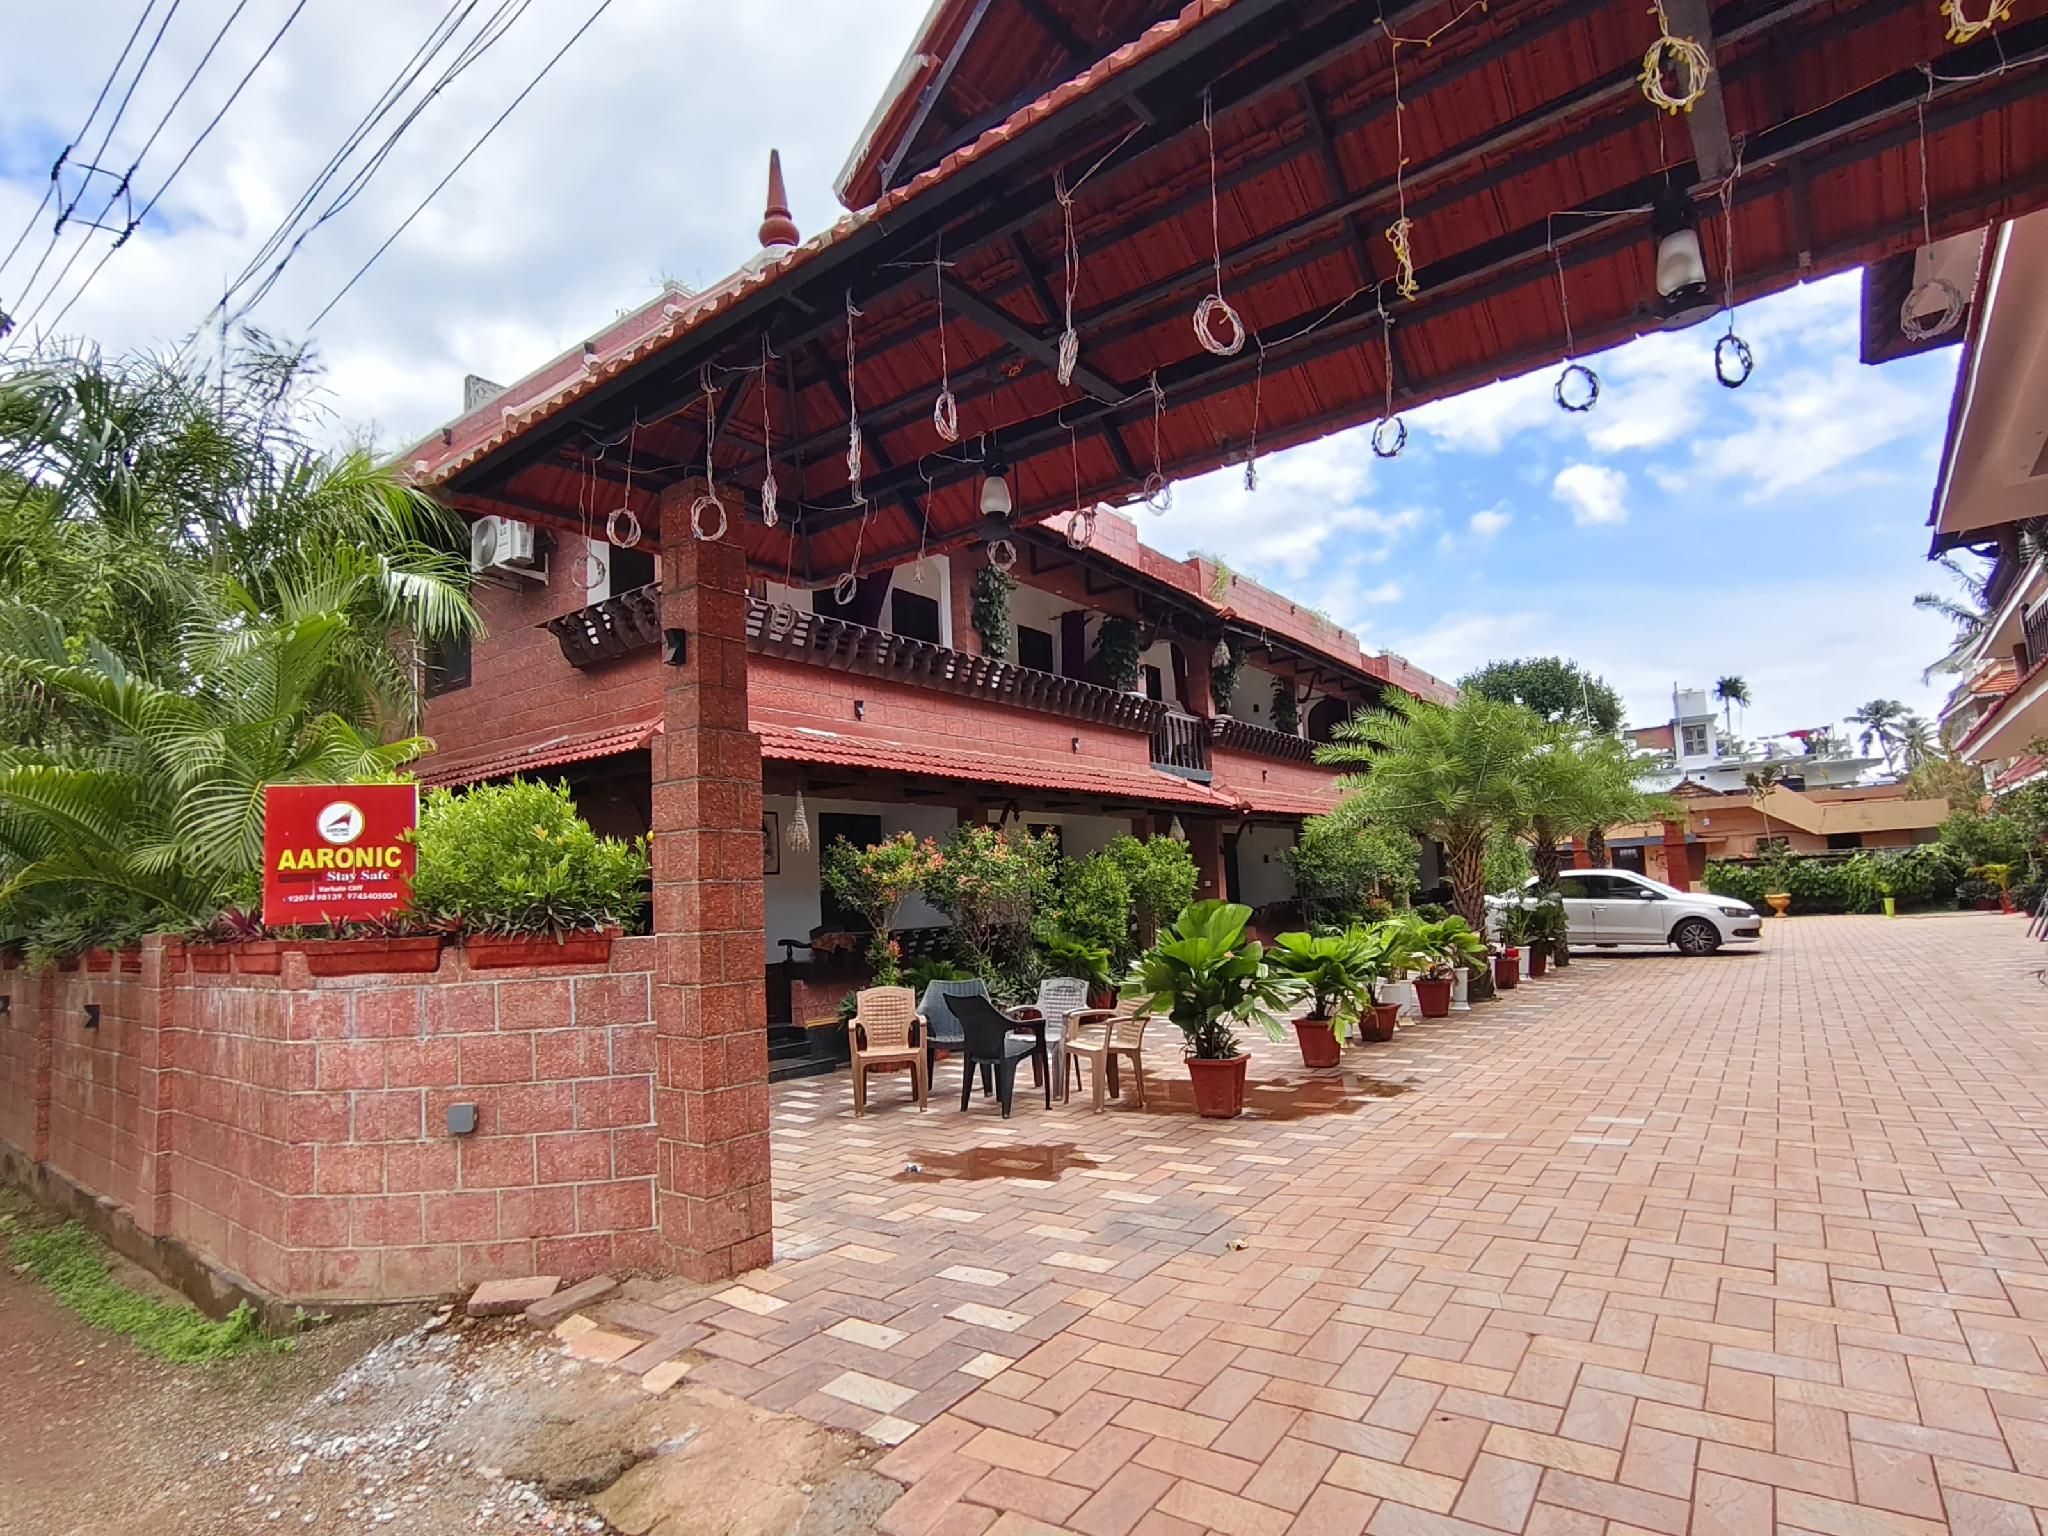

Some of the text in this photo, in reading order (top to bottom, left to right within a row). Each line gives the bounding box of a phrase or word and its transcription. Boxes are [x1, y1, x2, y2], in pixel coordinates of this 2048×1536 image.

[278, 846, 402, 870] AARONIC
[327, 870, 391, 883] Stay Safe
